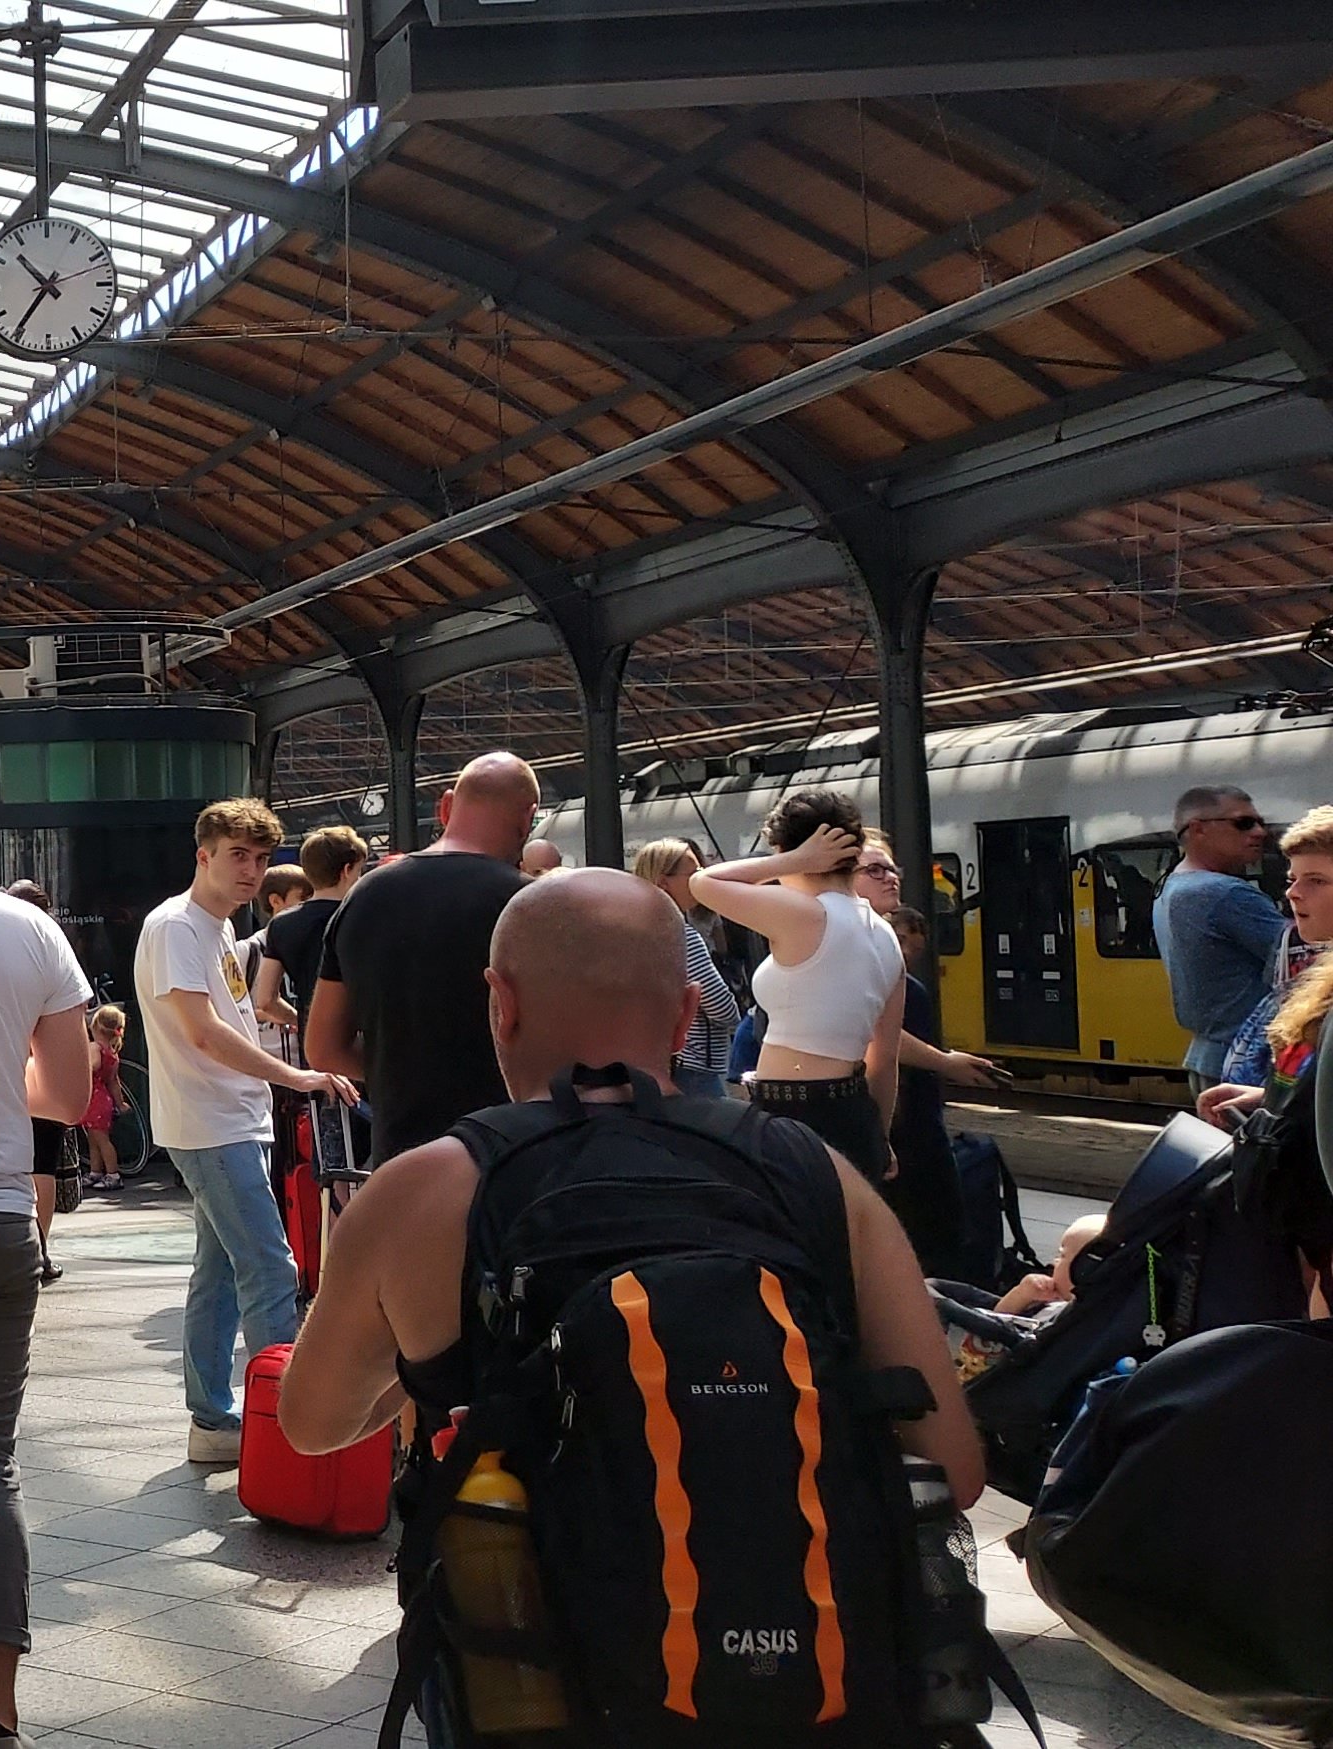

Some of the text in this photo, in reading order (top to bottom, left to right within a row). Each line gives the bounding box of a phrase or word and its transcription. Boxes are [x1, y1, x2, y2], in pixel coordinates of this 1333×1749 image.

[966, 862, 976, 890] 2
[1077, 856, 1089, 888] 2
[691, 1383, 769, 1395] BERGSON
[723, 1628, 799, 1655] CASUS
